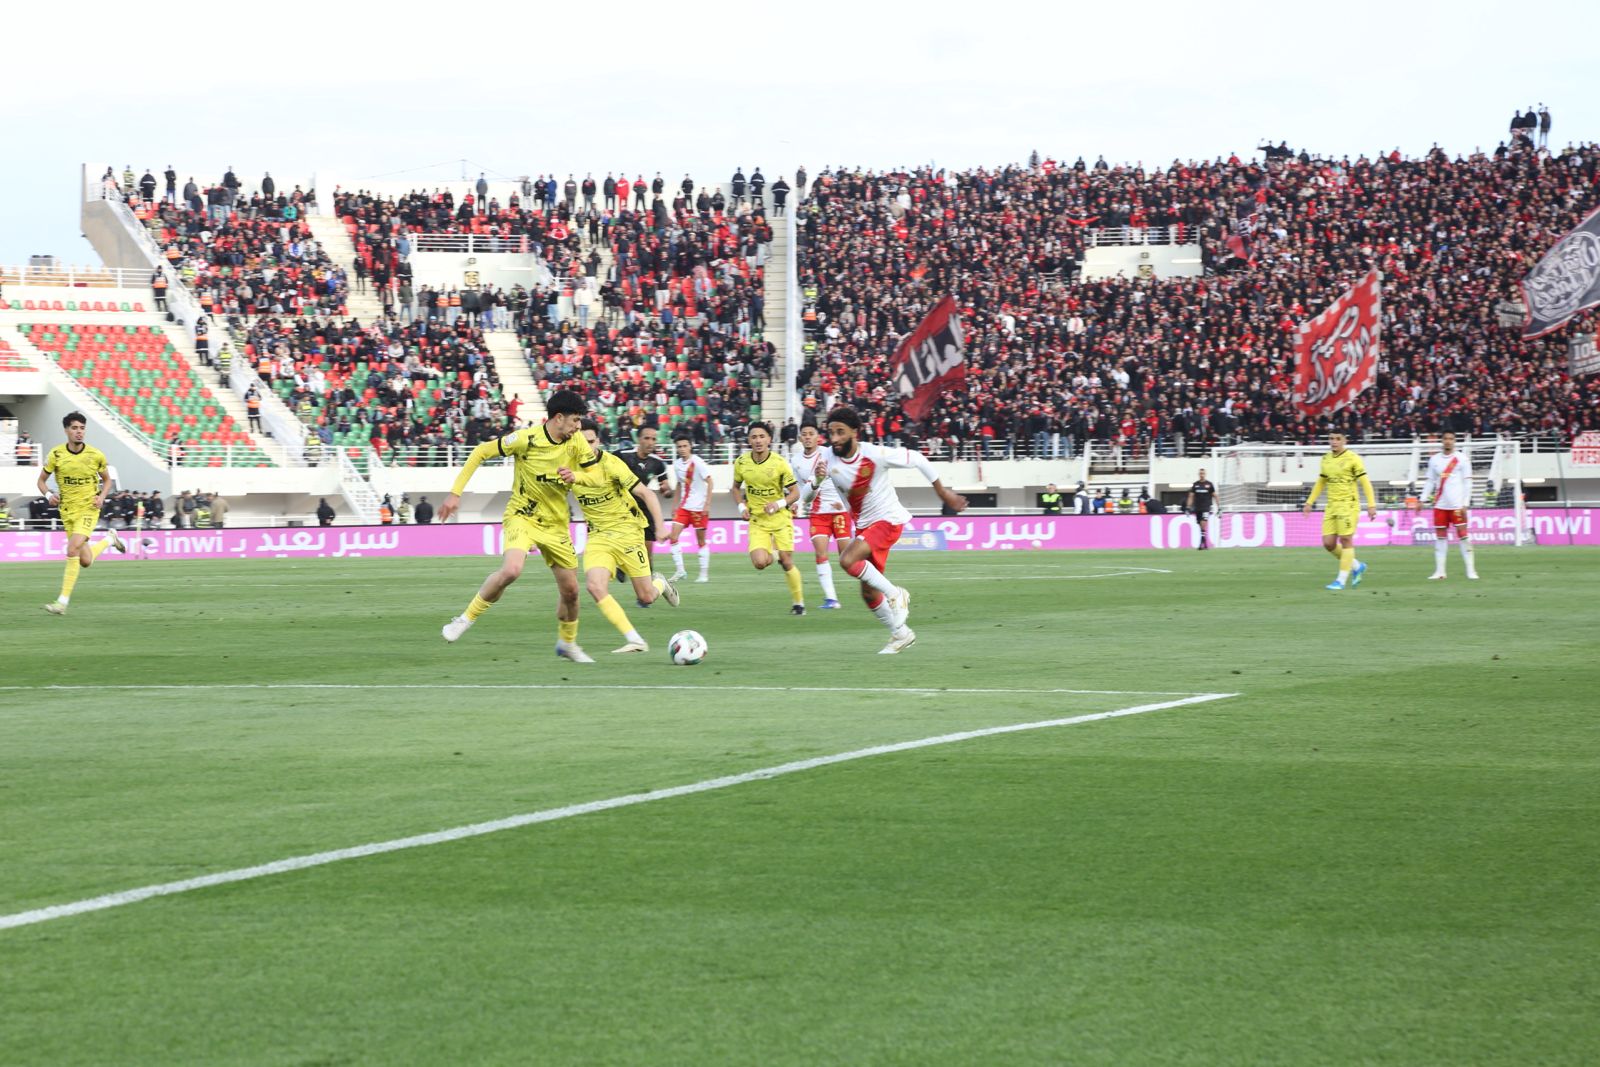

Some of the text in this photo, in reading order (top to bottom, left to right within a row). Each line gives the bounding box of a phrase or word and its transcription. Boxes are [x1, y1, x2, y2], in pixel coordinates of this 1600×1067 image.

[165, 530, 223, 553] inwi
[256, 531, 326, 557] بعيد
[332, 530, 399, 557] سير
